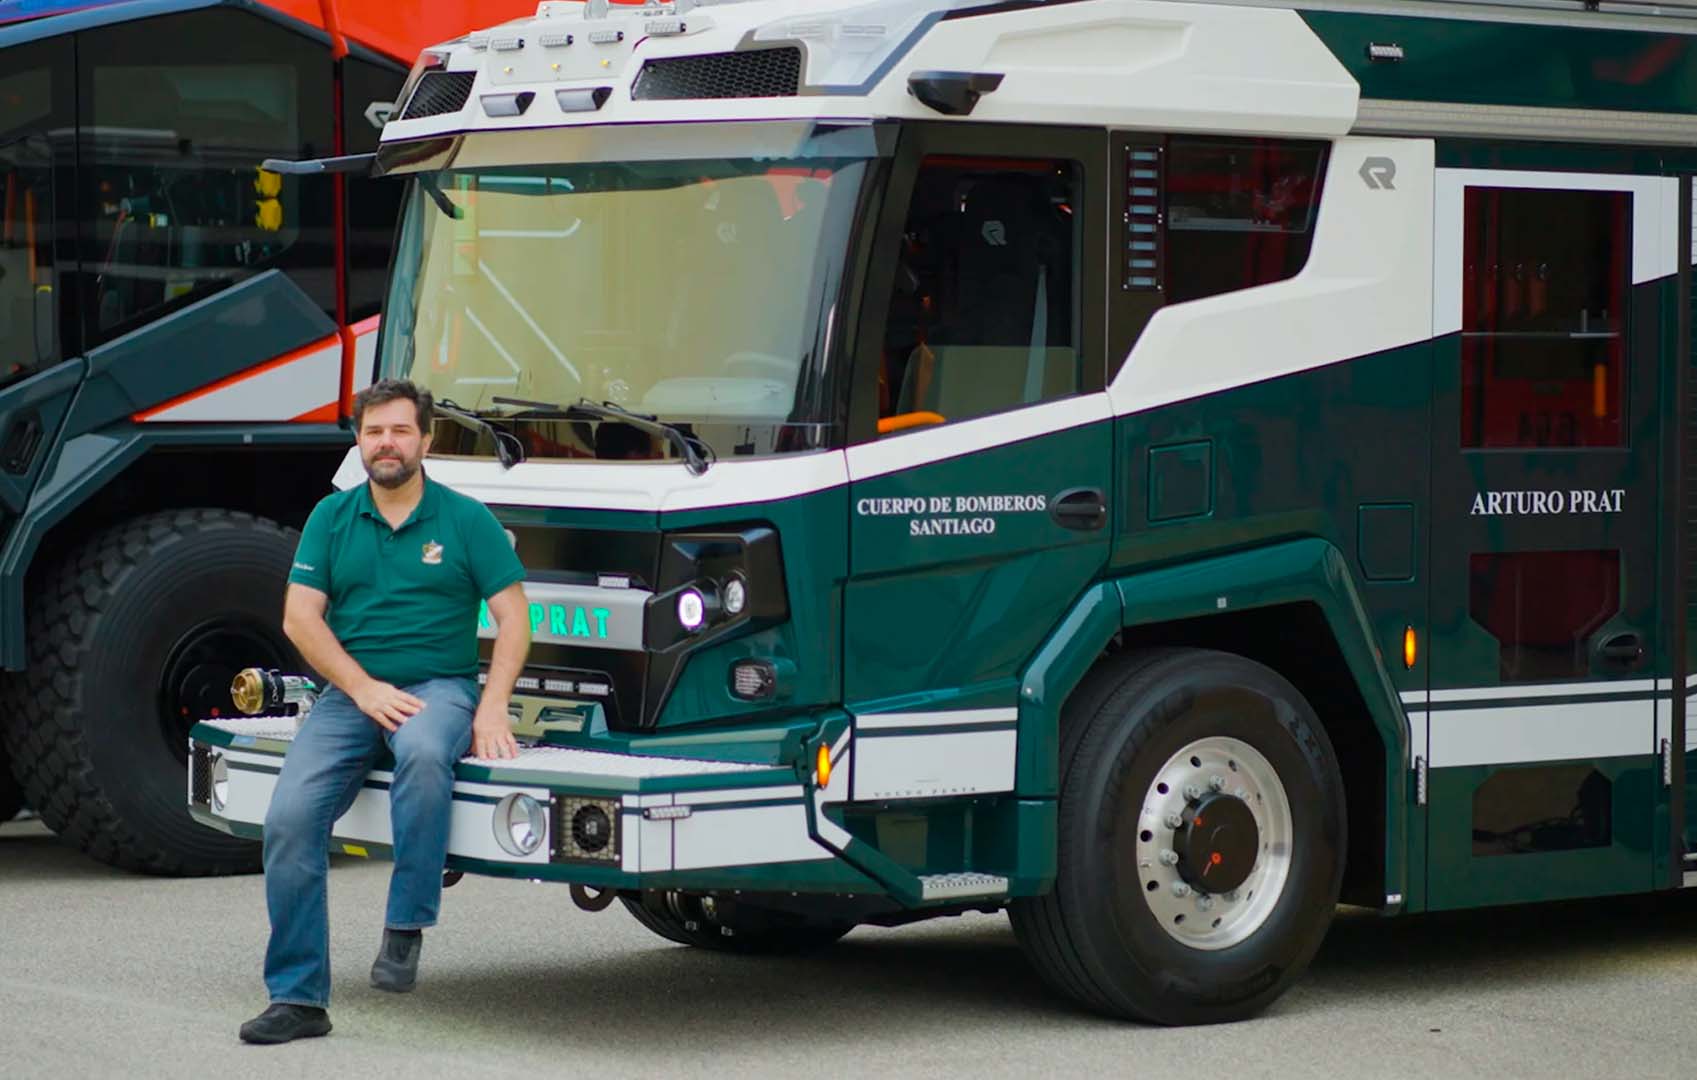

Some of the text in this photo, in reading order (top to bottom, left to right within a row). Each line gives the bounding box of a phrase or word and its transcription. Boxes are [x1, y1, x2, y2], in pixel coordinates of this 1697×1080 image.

[857, 495, 1046, 515] CUERPO DE BOMBEROS
[1470, 489, 1625, 515] ARTURO PRAT
[910, 517, 996, 536] SANTIAGO
[529, 602, 611, 638] PRAT
